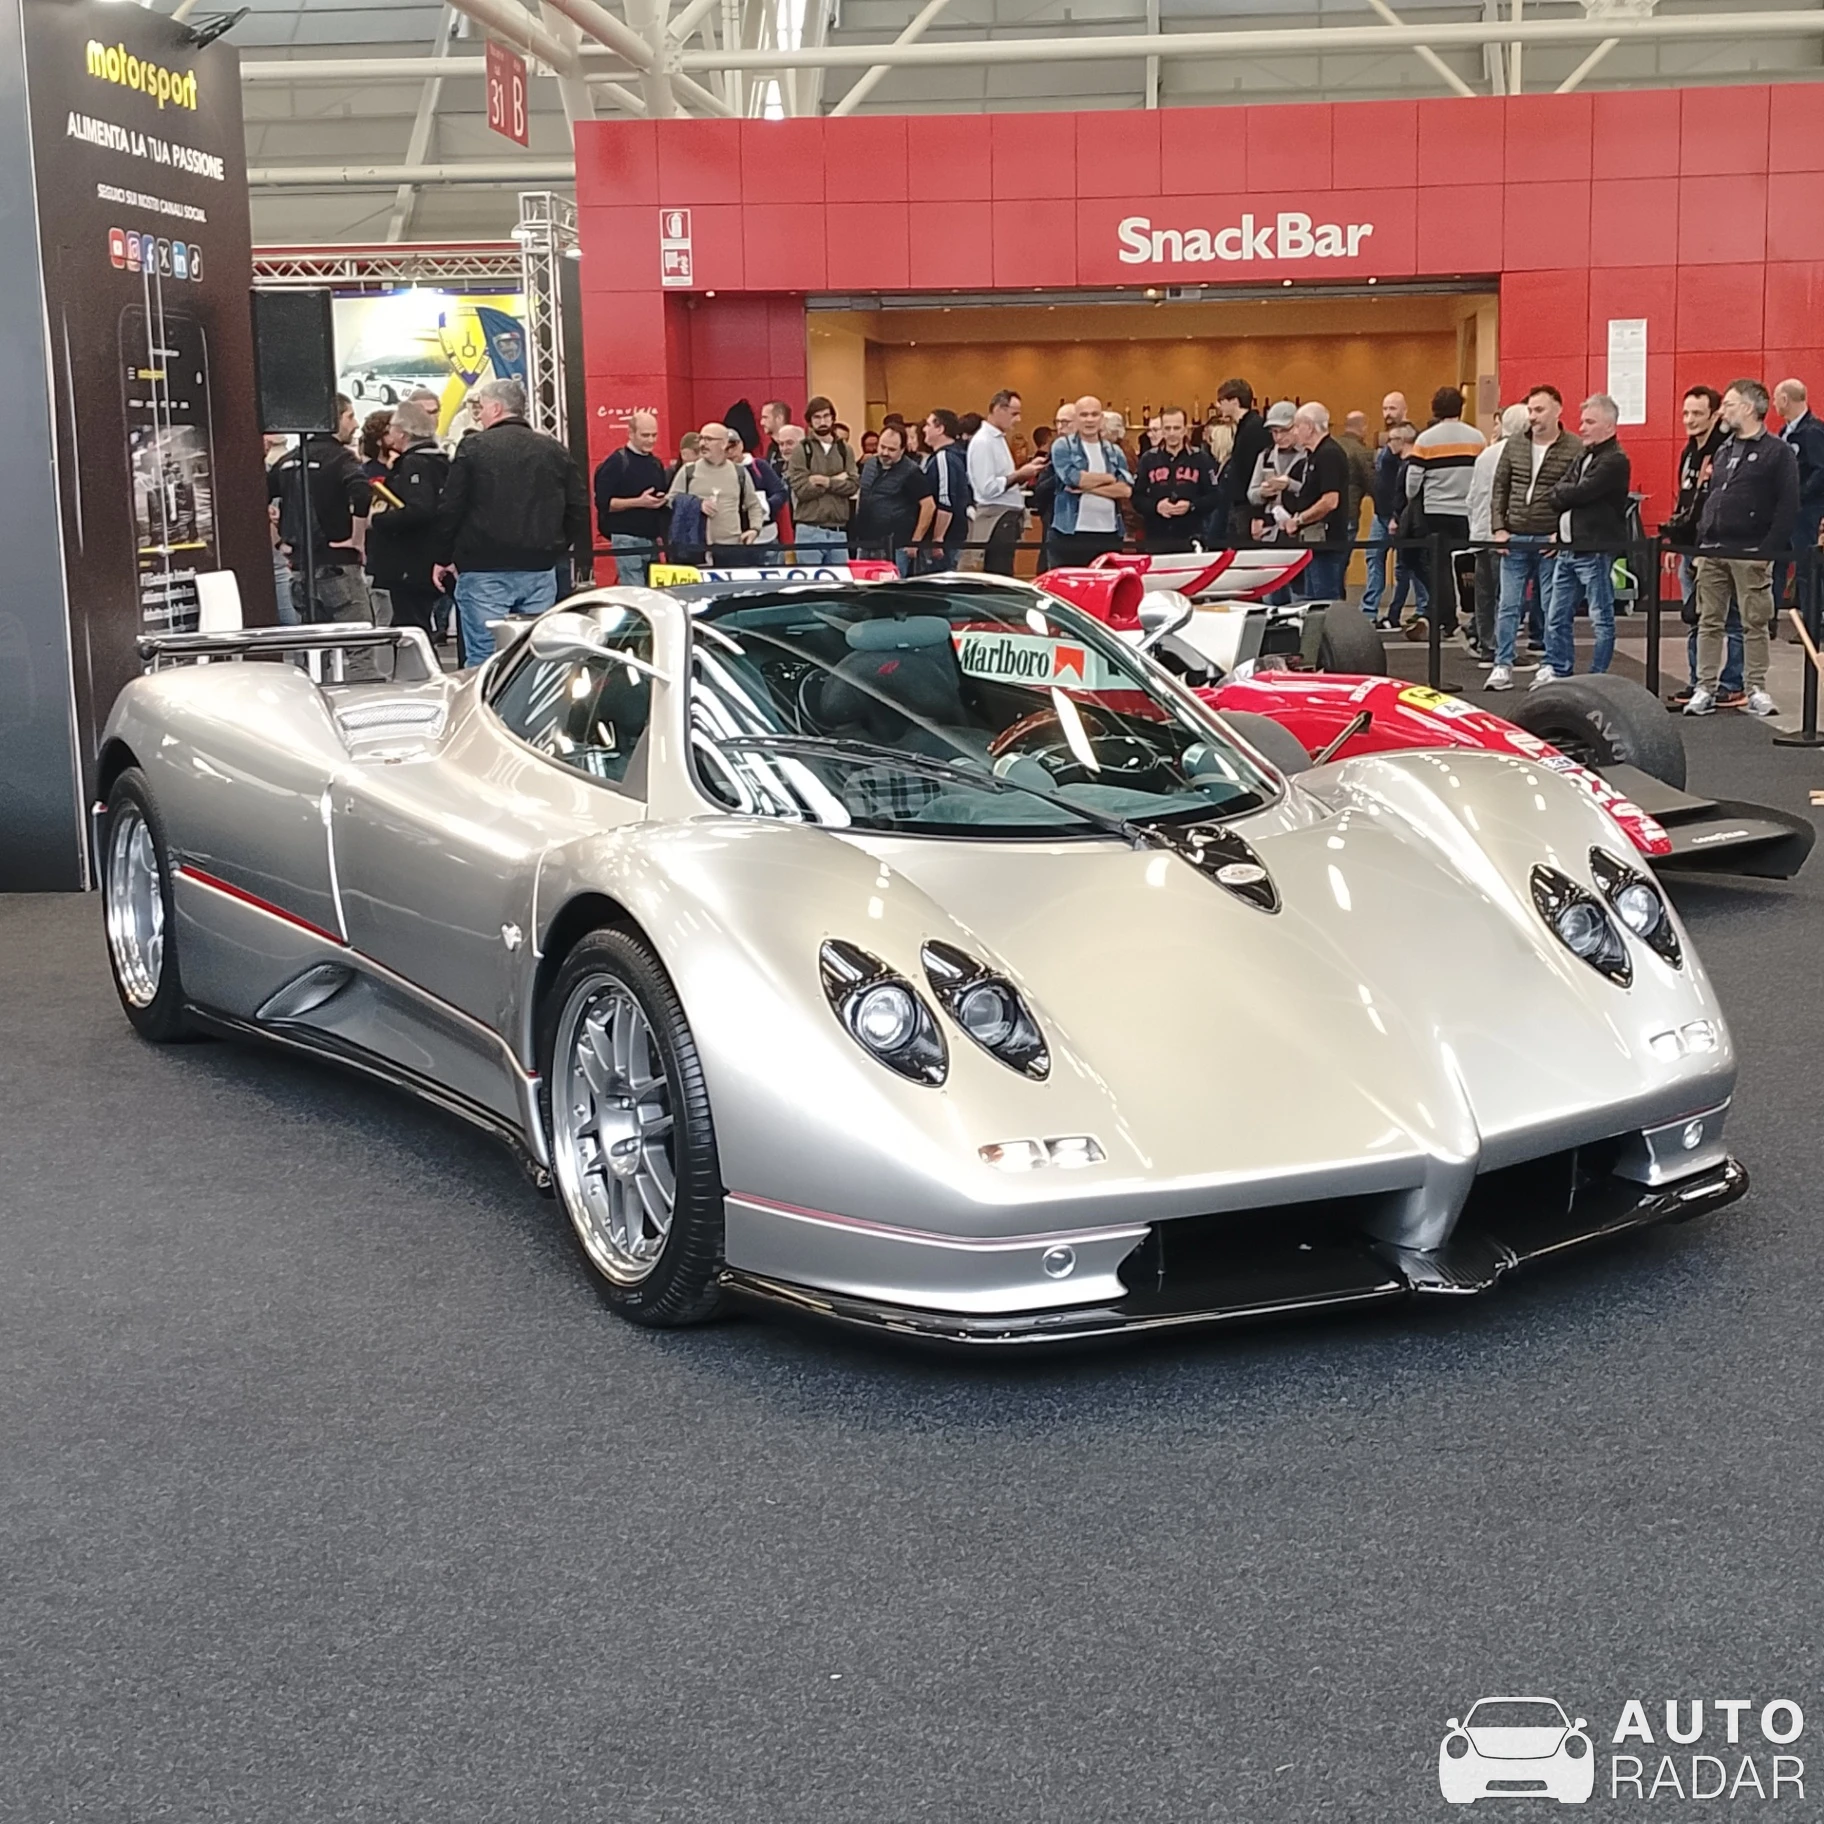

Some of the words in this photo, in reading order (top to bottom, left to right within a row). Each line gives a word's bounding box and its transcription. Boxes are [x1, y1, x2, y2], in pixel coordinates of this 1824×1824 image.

[86, 39, 197, 110] motorsport
[491, 79, 504, 128] 31
[513, 75, 524, 137] B
[67, 111, 129, 153] ALIMENTA
[130, 131, 147, 158] LA
[147, 136, 171, 165] TUA
[172, 144, 224, 180] PASSIONE
[1118, 212, 1374, 264] SnackBar
[961, 638, 1050, 678] Marlboro
[1586, 710, 1627, 761] AVO
